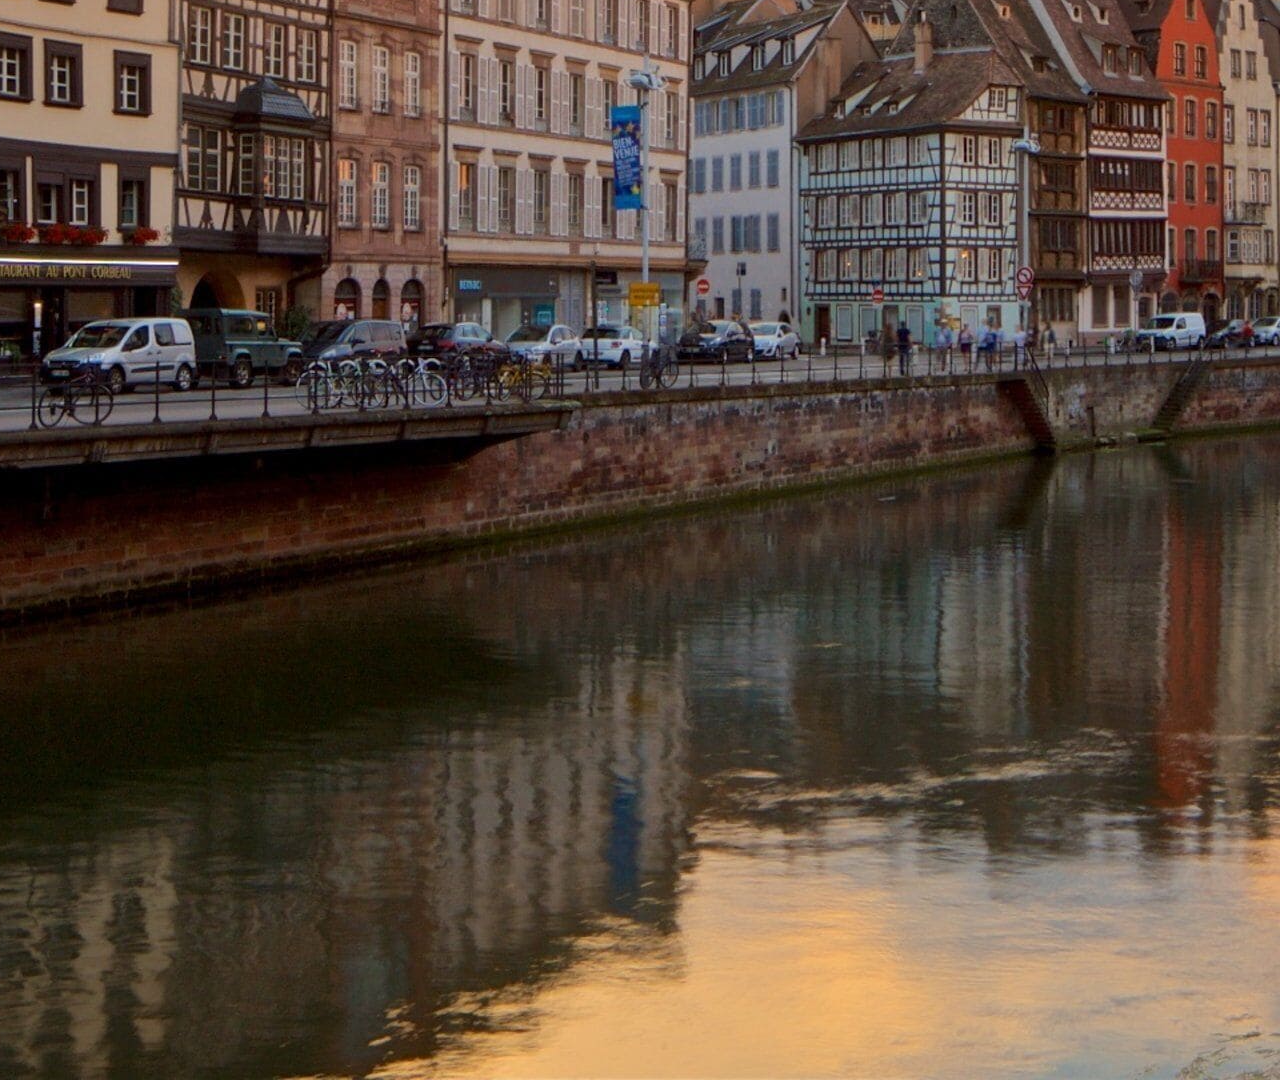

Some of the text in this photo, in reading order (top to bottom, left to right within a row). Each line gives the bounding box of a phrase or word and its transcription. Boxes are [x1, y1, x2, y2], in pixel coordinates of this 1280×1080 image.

[46, 265, 59, 278] AU
[63, 265, 86, 278] PONT
[91, 266, 131, 279] CORBEAU
